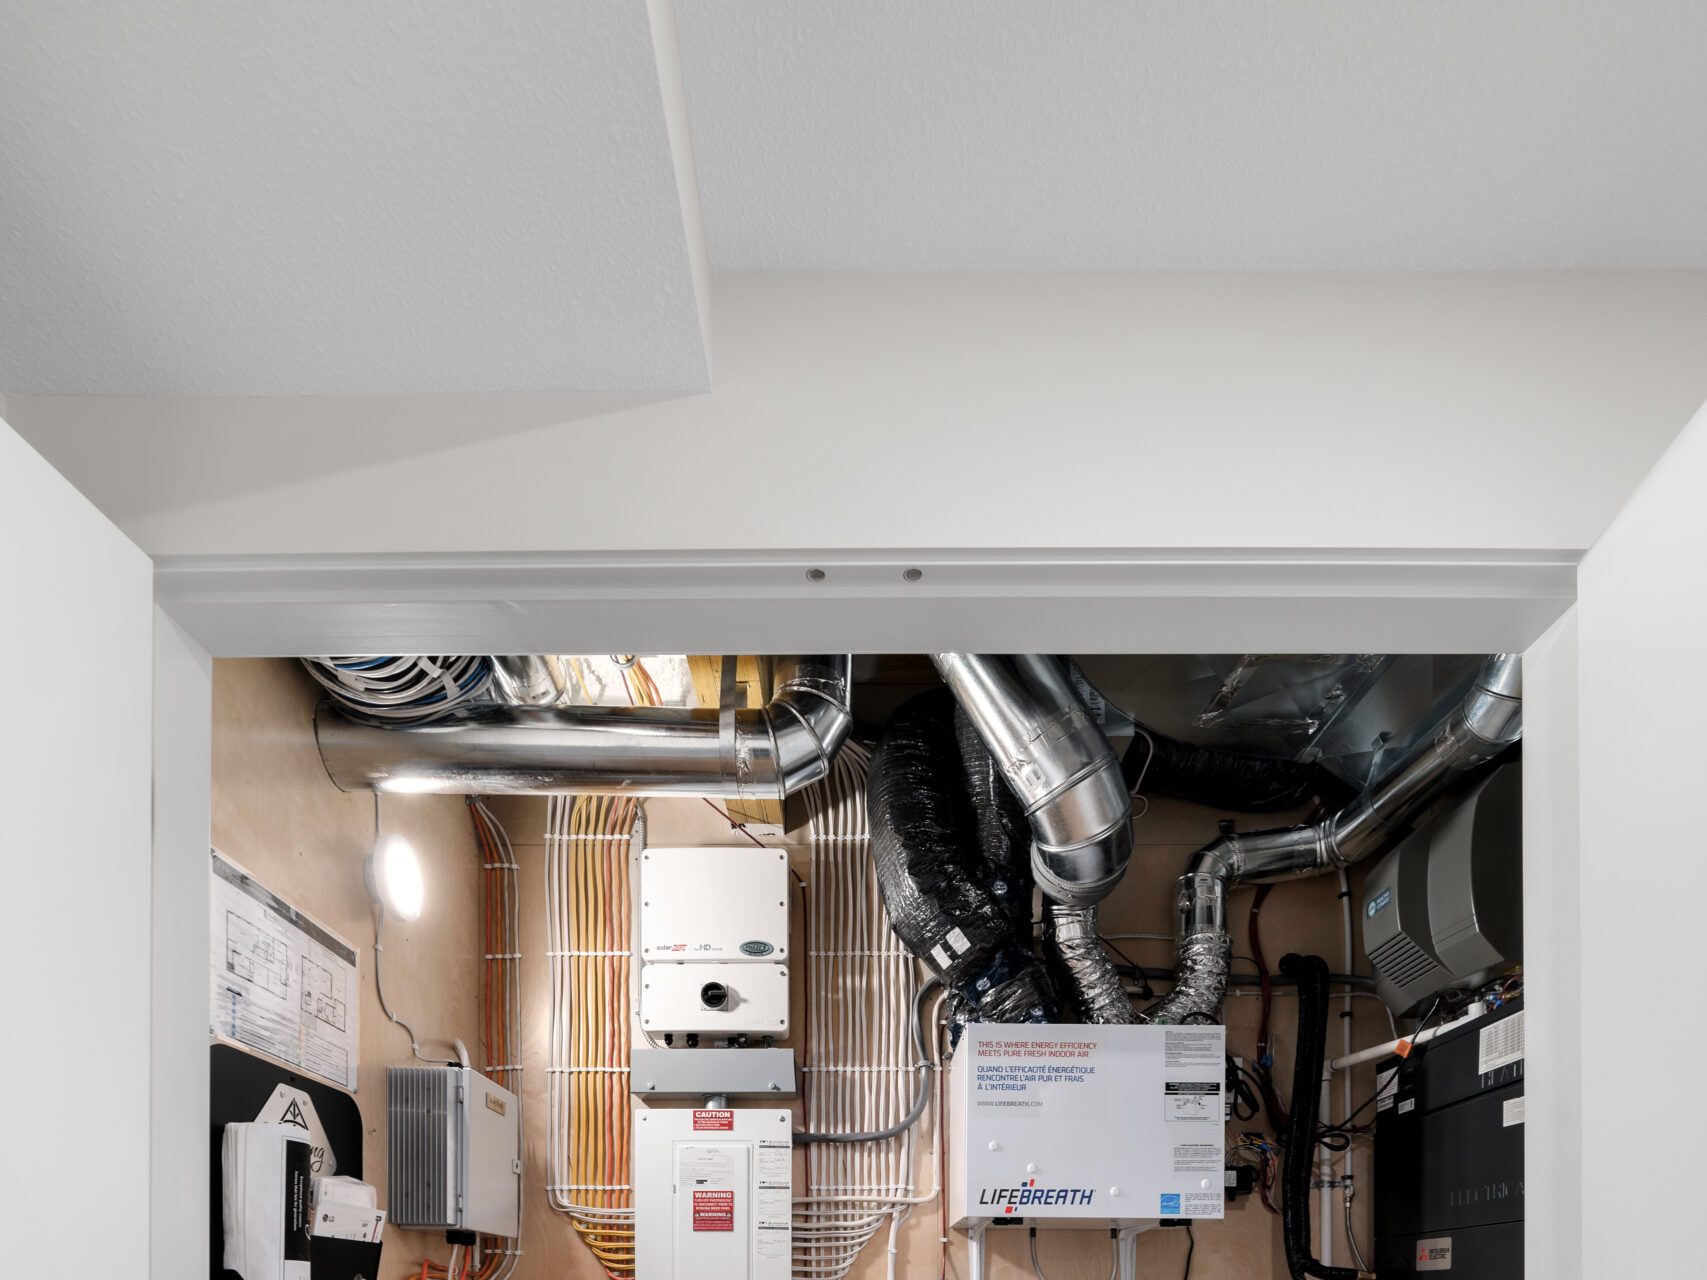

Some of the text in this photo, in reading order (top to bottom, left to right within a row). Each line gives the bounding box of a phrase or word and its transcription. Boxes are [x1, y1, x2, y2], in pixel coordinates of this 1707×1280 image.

[978, 1041, 1098, 1050] THIS IS WHERE ENERGY EFFICIENCY
[1023, 1050, 1047, 1058] FRESH
[977, 1065, 1003, 1073] QUAND
[1048, 1065, 1096, 1074] ÉNERGÉTIQUE
[977, 1074, 1018, 1082] RENCONTRE
[1020, 1074, 1036, 1082] L'AIR
[1064, 1075, 1085, 1083] FRAIS
[977, 1082, 1027, 1091] À L'INTÉRIEUR
[977, 1100, 1043, 1108] WWW.LIFEBREATH.COM
[979, 1189, 1094, 1205] LIFEBREATH
